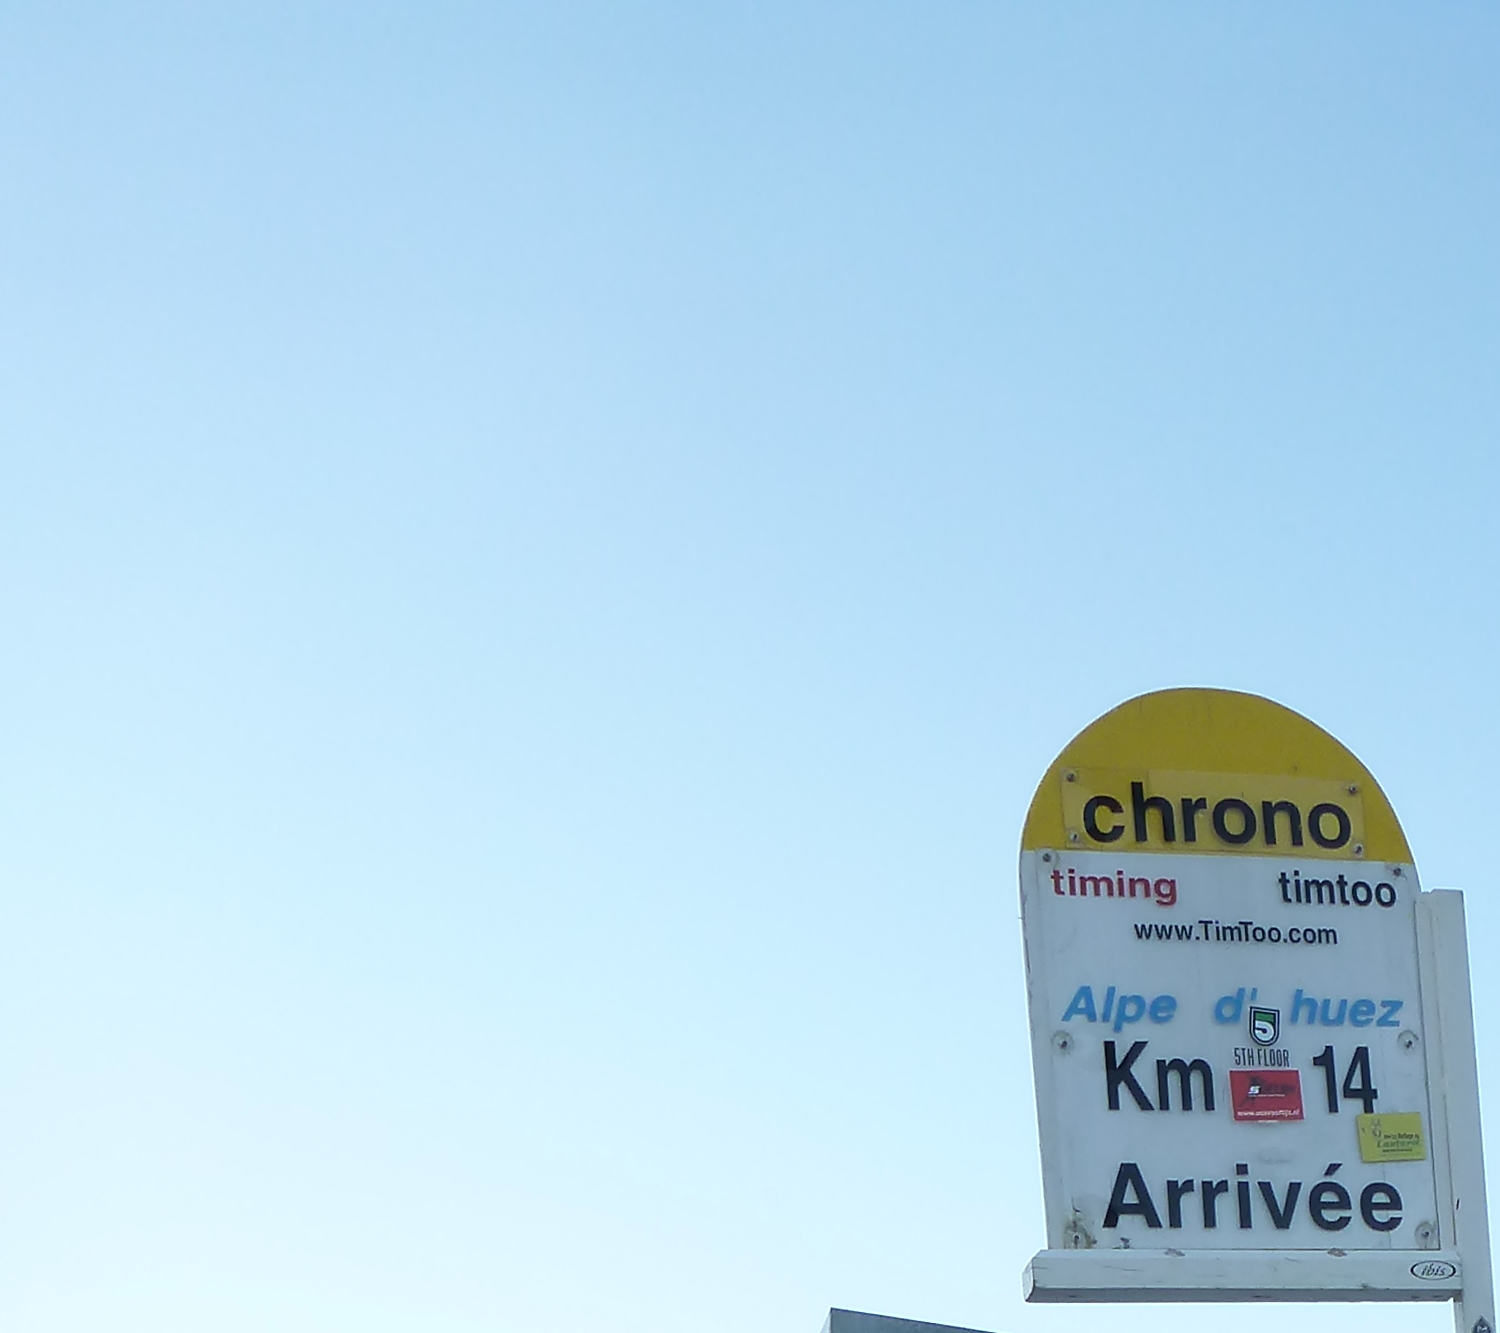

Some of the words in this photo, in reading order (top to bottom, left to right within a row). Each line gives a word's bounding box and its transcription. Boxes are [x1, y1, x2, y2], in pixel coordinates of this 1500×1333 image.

[1081, 781, 1353, 850] chrono
[1050, 868, 1179, 907] timing
[1278, 871, 1398, 908] timtoo
[1134, 919, 1339, 945] www.TimToo.com
[1061, 985, 1178, 1033] Alpe
[1214, 987, 1259, 1025] d'
[1289, 988, 1404, 1028] huez
[1102, 1039, 1217, 1112] Km
[1312, 1045, 1379, 1114] 14
[1232, 1046, 1255, 1067] 5TH
[1257, 1047, 1291, 1068] FLOOR
[1101, 1161, 1404, 1232] Arrivée
